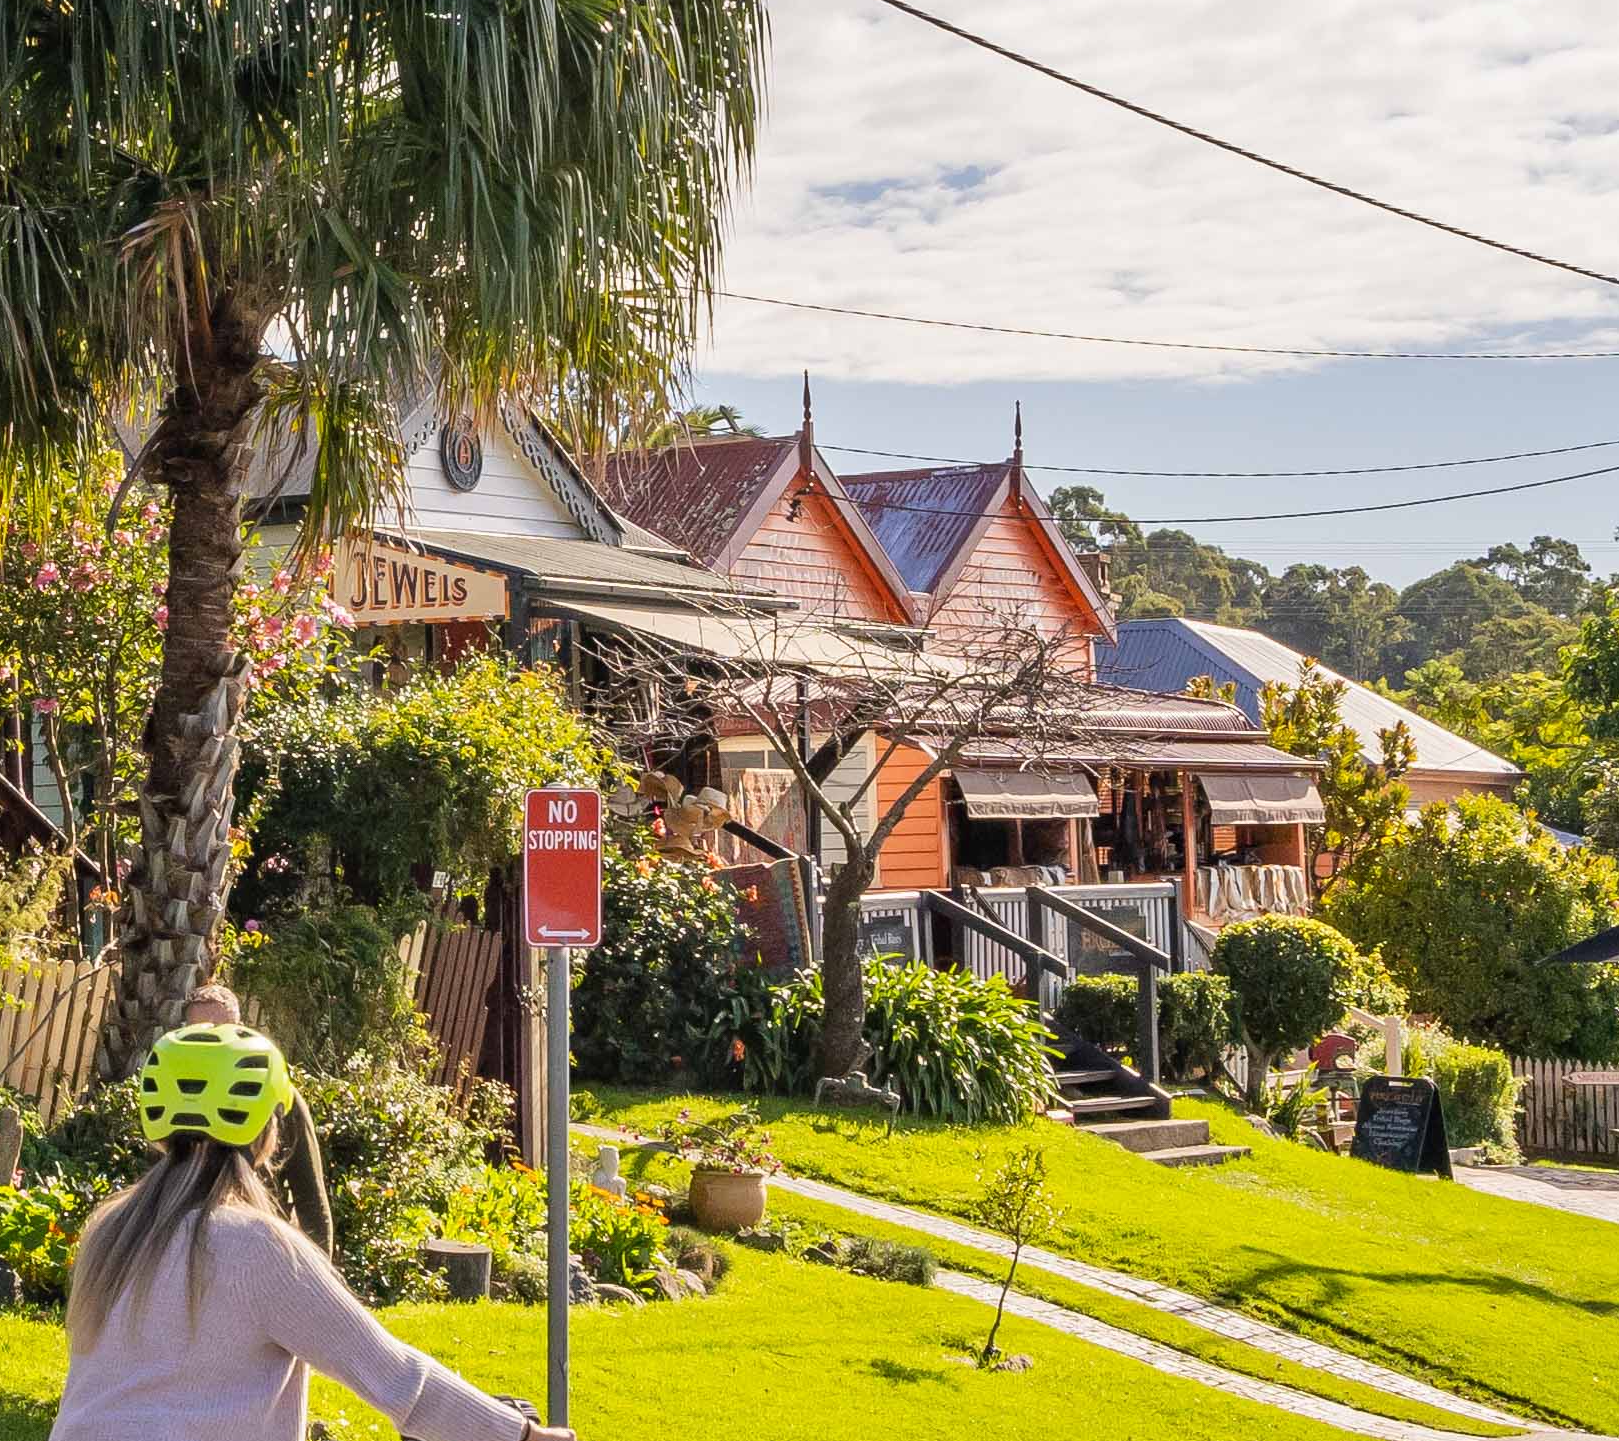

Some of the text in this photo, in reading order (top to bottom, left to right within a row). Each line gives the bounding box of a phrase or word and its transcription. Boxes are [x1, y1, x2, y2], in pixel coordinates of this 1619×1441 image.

[350, 551, 468, 612] JEWELS
[548, 799, 578, 824] NO
[528, 830, 597, 850] STOPPING
